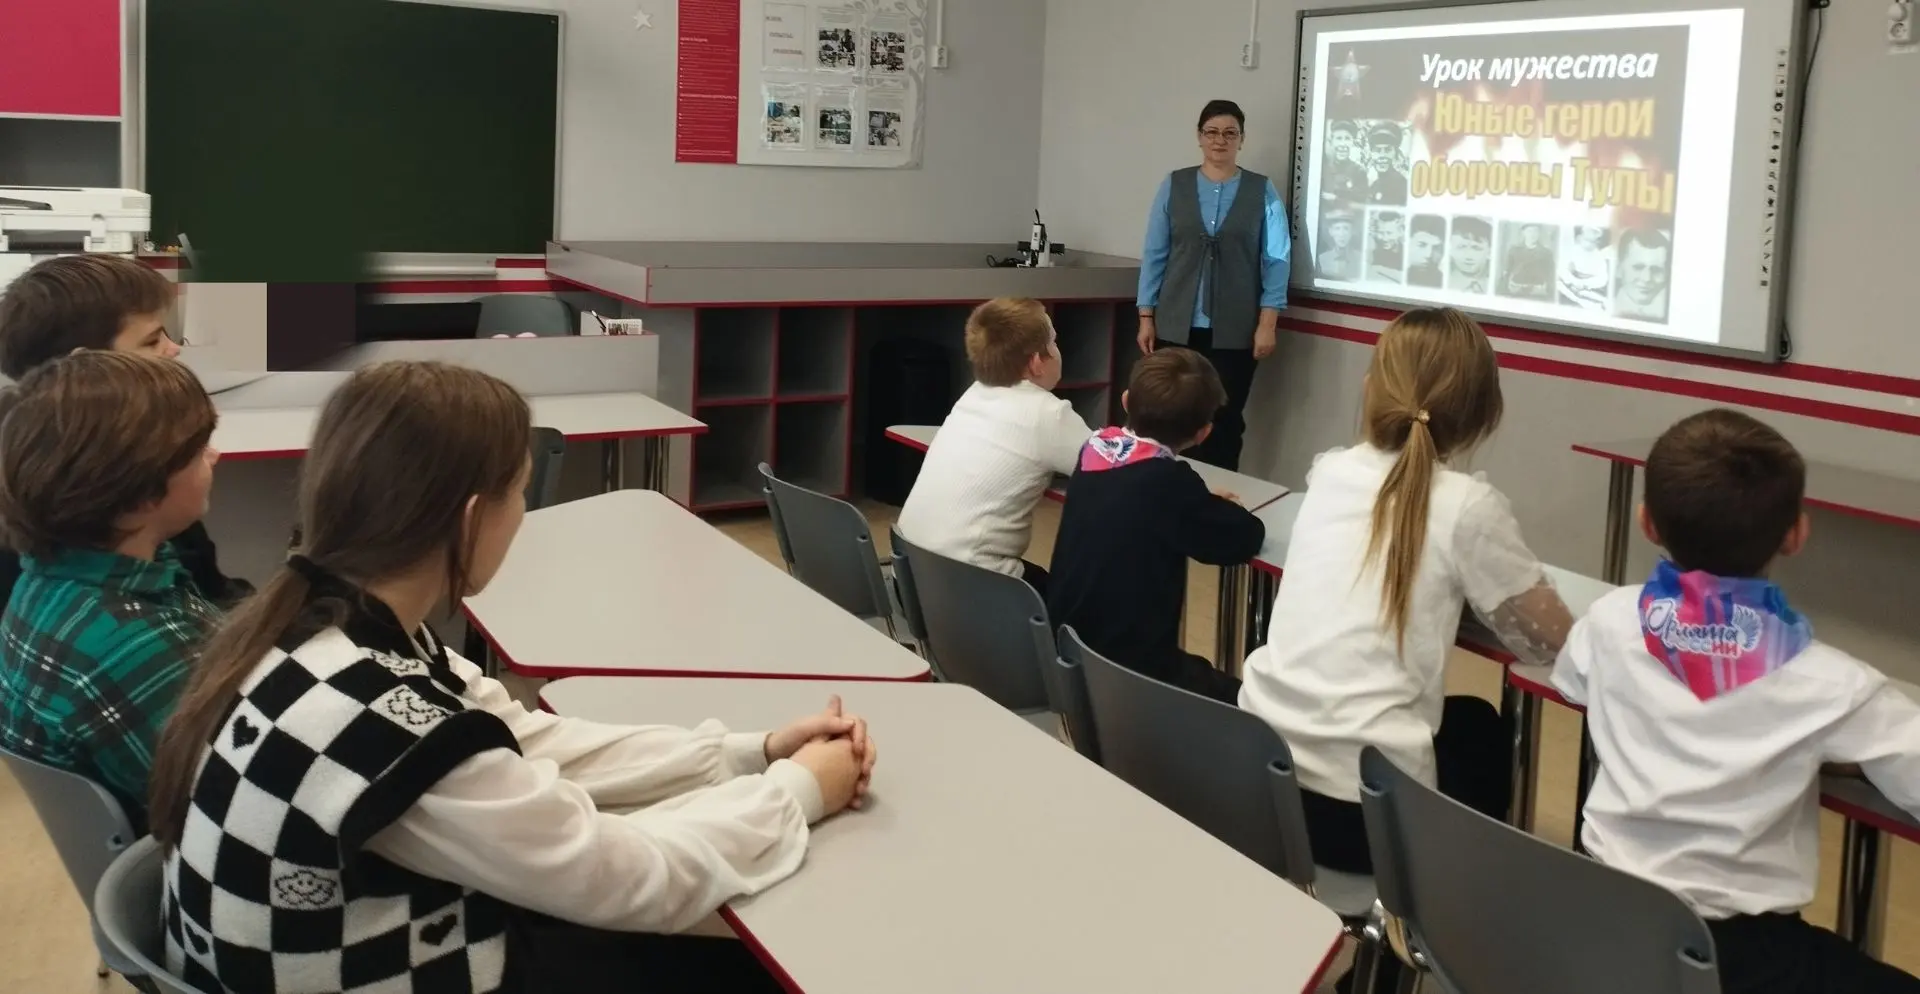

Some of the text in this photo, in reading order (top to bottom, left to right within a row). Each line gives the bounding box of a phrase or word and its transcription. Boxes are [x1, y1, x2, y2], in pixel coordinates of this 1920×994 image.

[1420, 52, 1659, 88] Урок мужества
[1434, 91, 1536, 138] Юные
[1410, 154, 1676, 215] обороны Тулы
